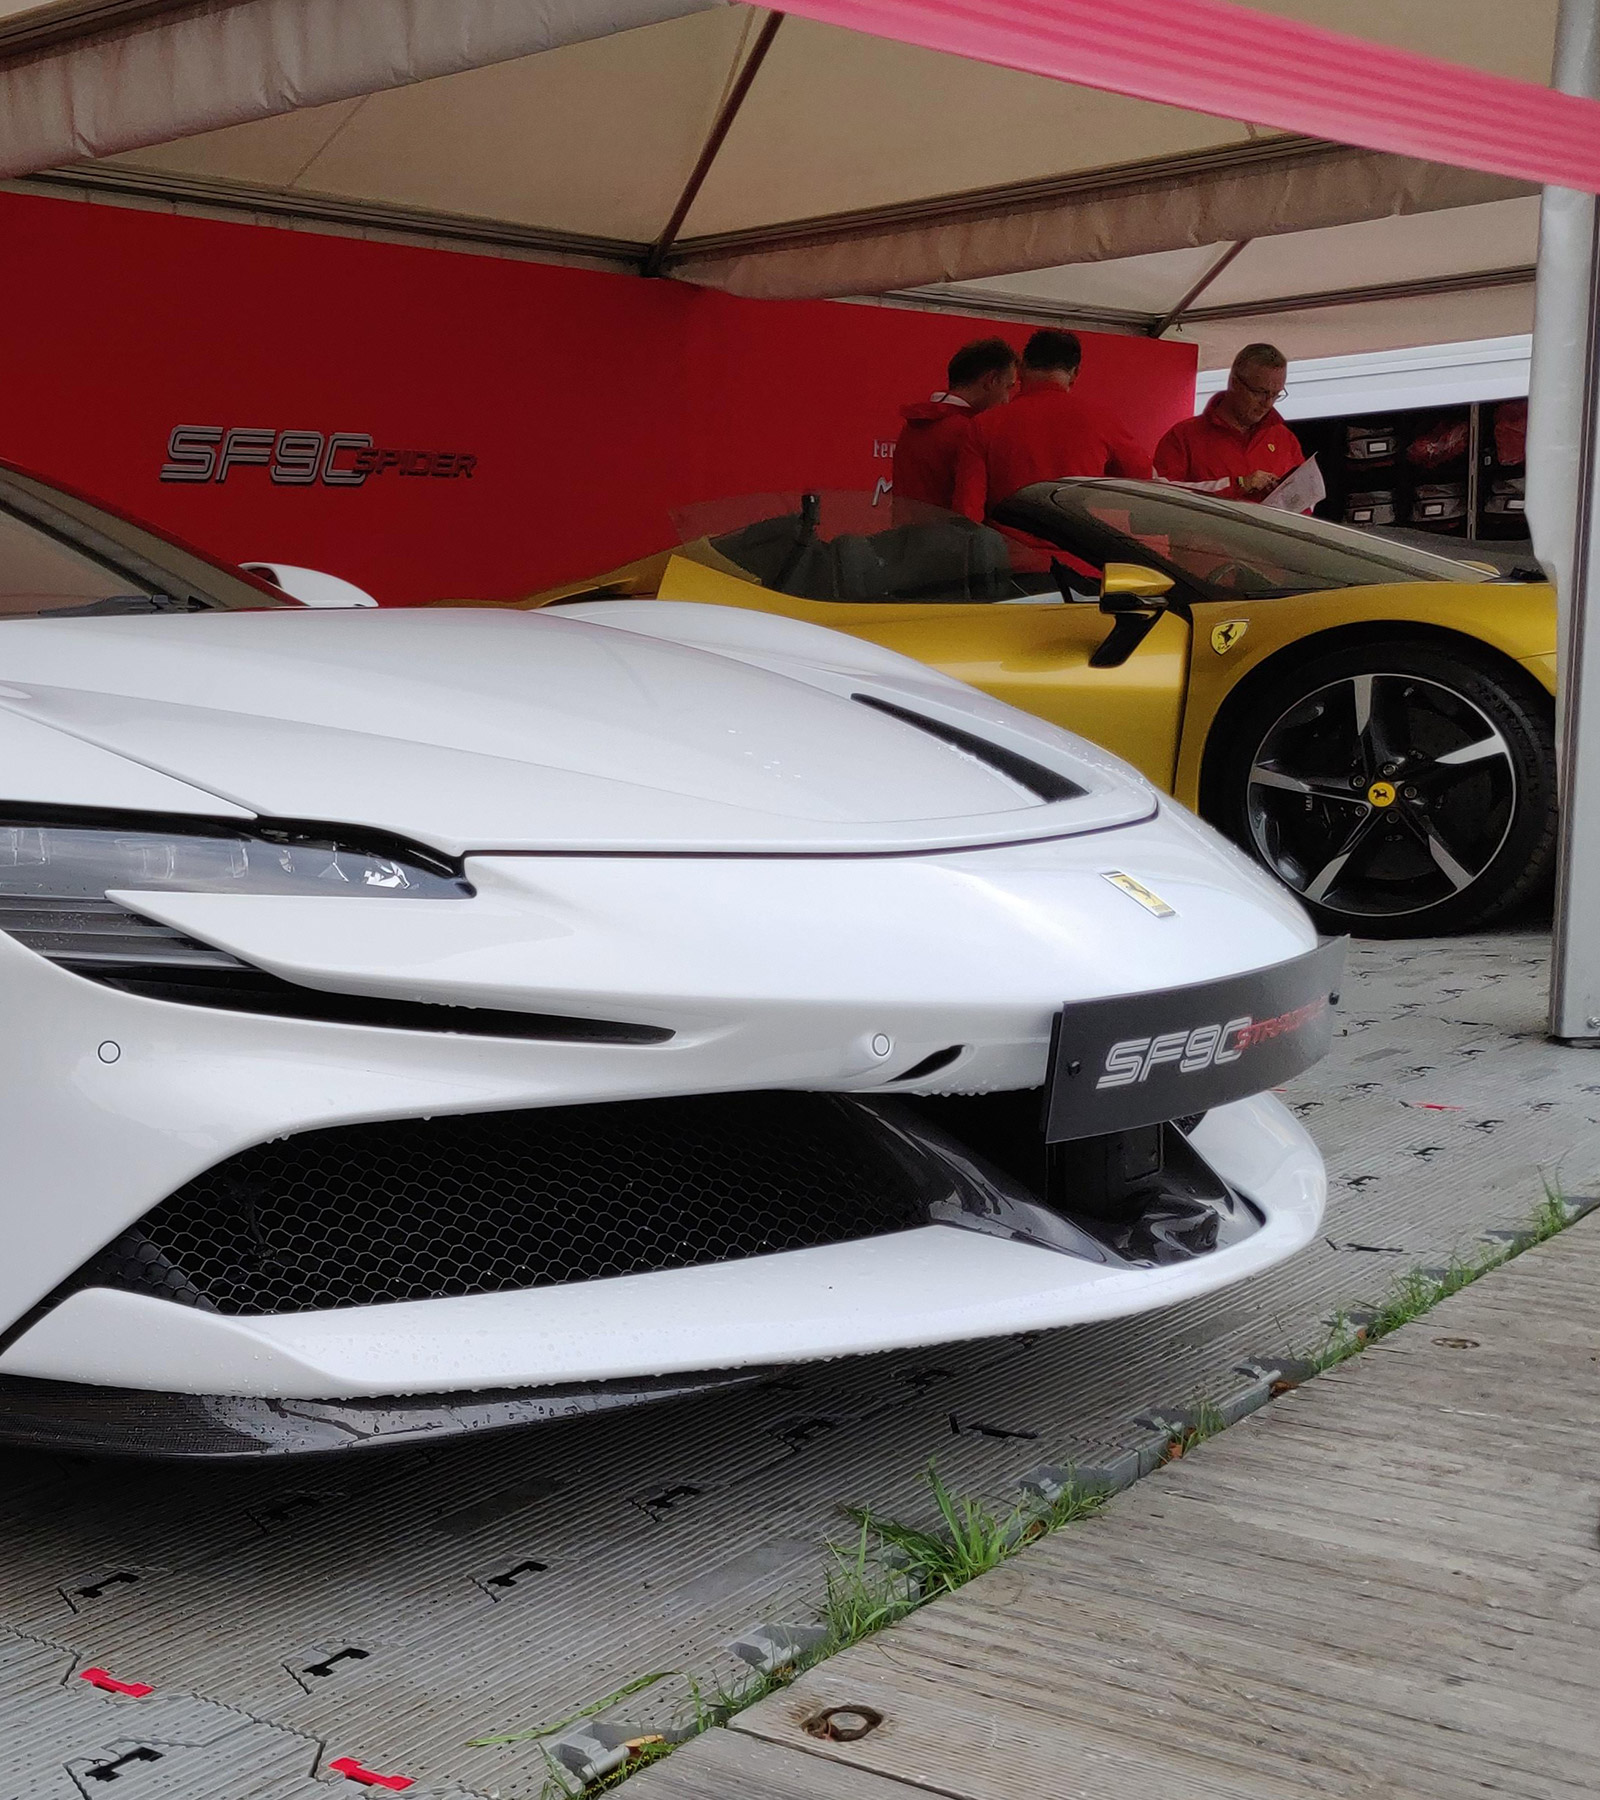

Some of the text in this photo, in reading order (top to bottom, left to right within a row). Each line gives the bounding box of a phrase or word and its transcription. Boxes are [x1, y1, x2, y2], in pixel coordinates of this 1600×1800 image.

[159, 424, 478, 485] SF90 SPIDER
[1095, 1016, 1252, 1090] SF90
